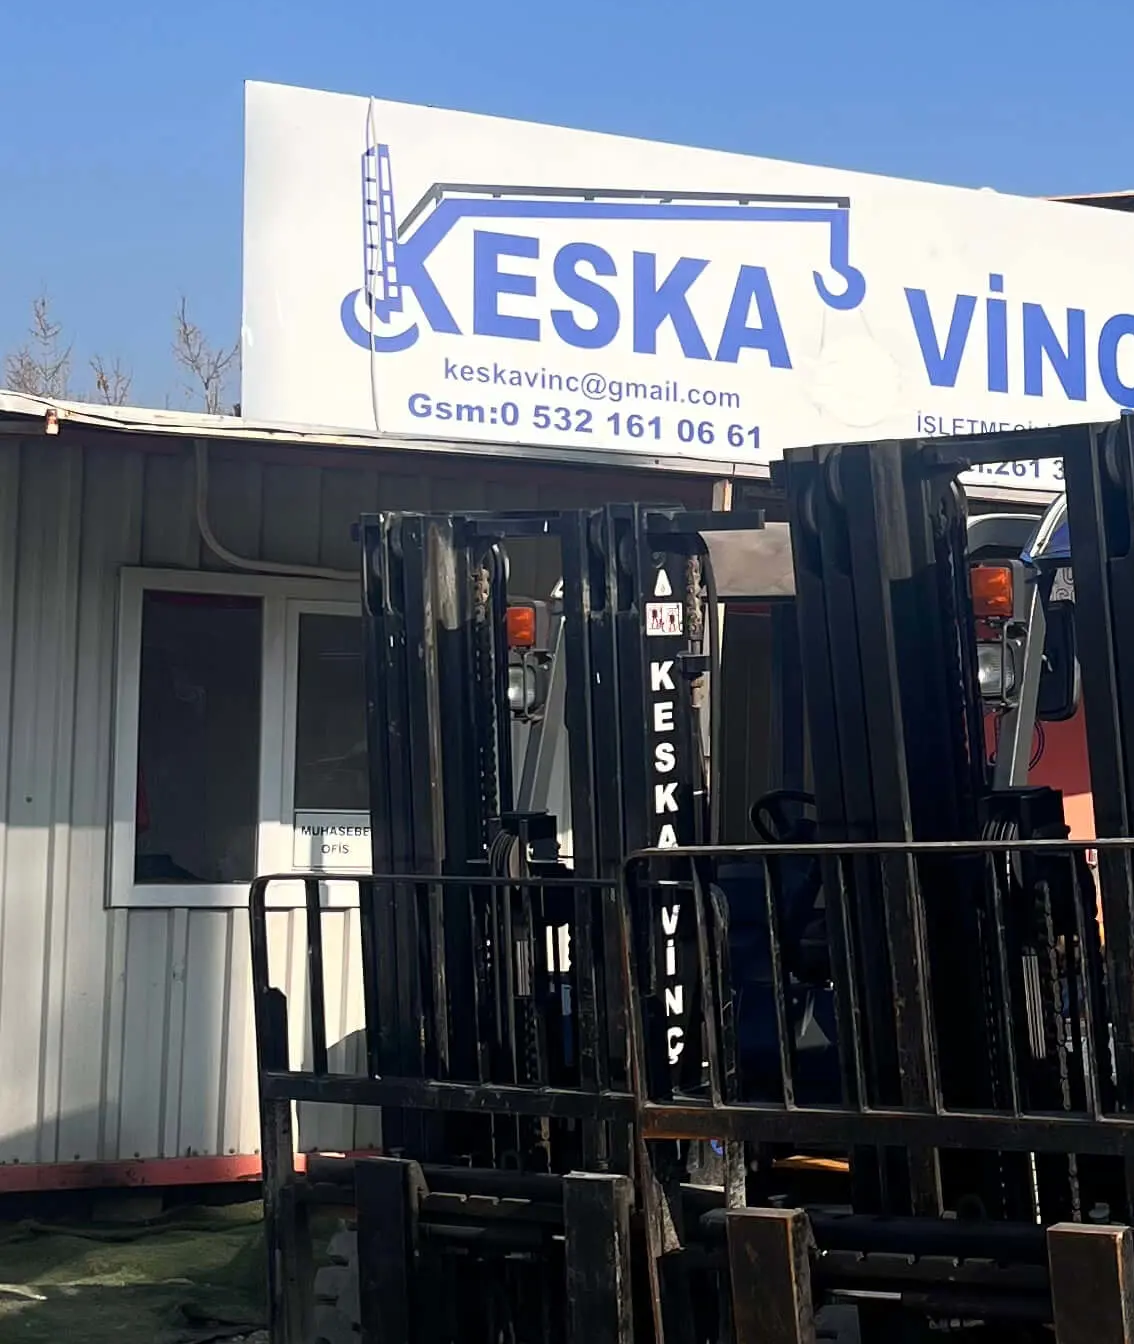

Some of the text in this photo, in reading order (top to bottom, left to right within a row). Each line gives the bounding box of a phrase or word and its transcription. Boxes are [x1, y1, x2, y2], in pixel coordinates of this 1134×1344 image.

[362, 196, 795, 370] KESKA
[444, 357, 741, 409] keskavinc@gmail.com
[407, 392, 762, 449] Gsm:0 532 161 06 61
[301, 825, 371, 838] MUHASEBE
[650, 660, 685, 1065] KESKA VİNÇ
